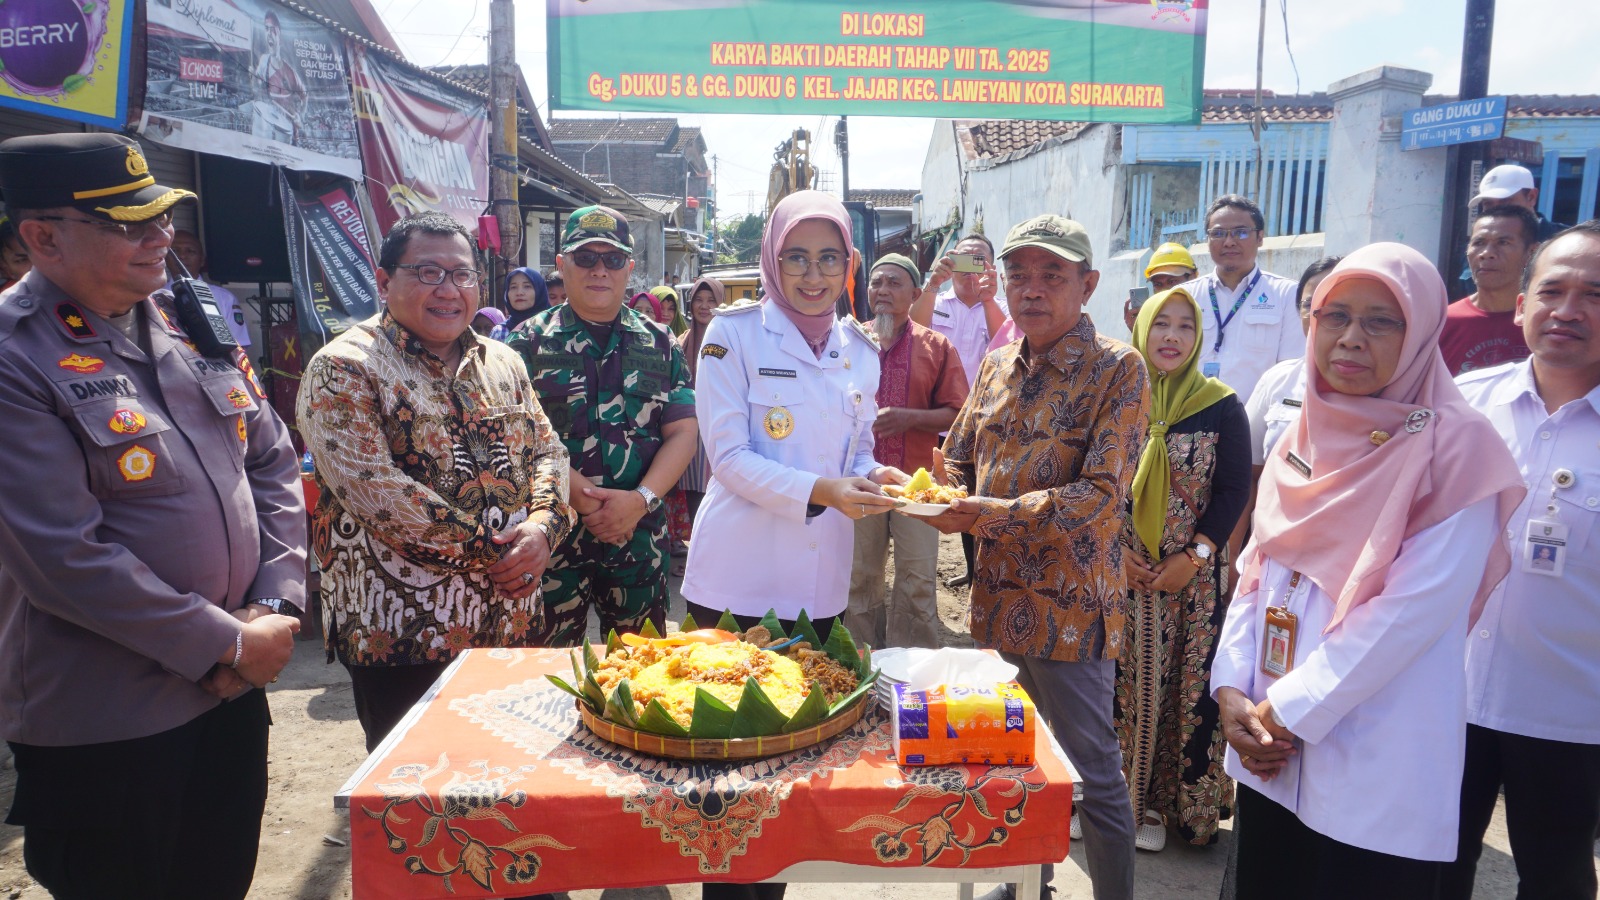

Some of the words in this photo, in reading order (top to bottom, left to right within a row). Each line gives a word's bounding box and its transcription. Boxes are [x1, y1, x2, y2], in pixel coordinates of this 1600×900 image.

[175, 0, 236, 32] Diplomat
[842, 13, 859, 35] DI
[862, 13, 924, 36] LOKASI
[0, 22, 79, 48] BERRY
[301, 59, 318, 69] GAK
[712, 43, 767, 66] KARYA
[770, 44, 821, 67] BAKTI
[824, 45, 892, 68] DAERAH
[896, 47, 950, 69] TAHAP
[953, 48, 975, 70] VII
[979, 49, 1004, 71] TA.
[1007, 50, 1049, 72] 2025
[187, 62, 221, 79] CHOOSE
[305, 69, 337, 80] SITUASI
[195, 82, 218, 99] LIVE!
[588, 73, 617, 101] Gg.
[620, 74, 667, 97] DUKU
[670, 75, 682, 97] 5
[685, 75, 698, 97] &
[702, 75, 731, 98] GG.
[734, 75, 781, 98] DUKU
[784, 76, 796, 99] 6
[803, 76, 840, 100] KEL.
[843, 77, 898, 101] JAJAR
[902, 78, 939, 102] KEC.
[942, 80, 1024, 104] LAWEYAN
[1025, 82, 1066, 105] KOTA
[1069, 83, 1164, 108] SURAKARTA
[1412, 108, 1443, 125] GANG
[1446, 102, 1481, 120] DUKU
[1486, 101, 1495, 114] V
[447, 193, 485, 211] FILTER
[330, 200, 371, 255] REVOLU
[320, 217, 342, 242] BATANG
[338, 240, 359, 264] LURUS
[308, 219, 330, 246] KERTAS
[324, 244, 345, 269] FILTER
[339, 268, 355, 285] ANTI
[350, 279, 373, 304] BASAH
[314, 282, 323, 293] RP
[314, 295, 347, 334] 16.00
[69, 378, 130, 400] DANNY
